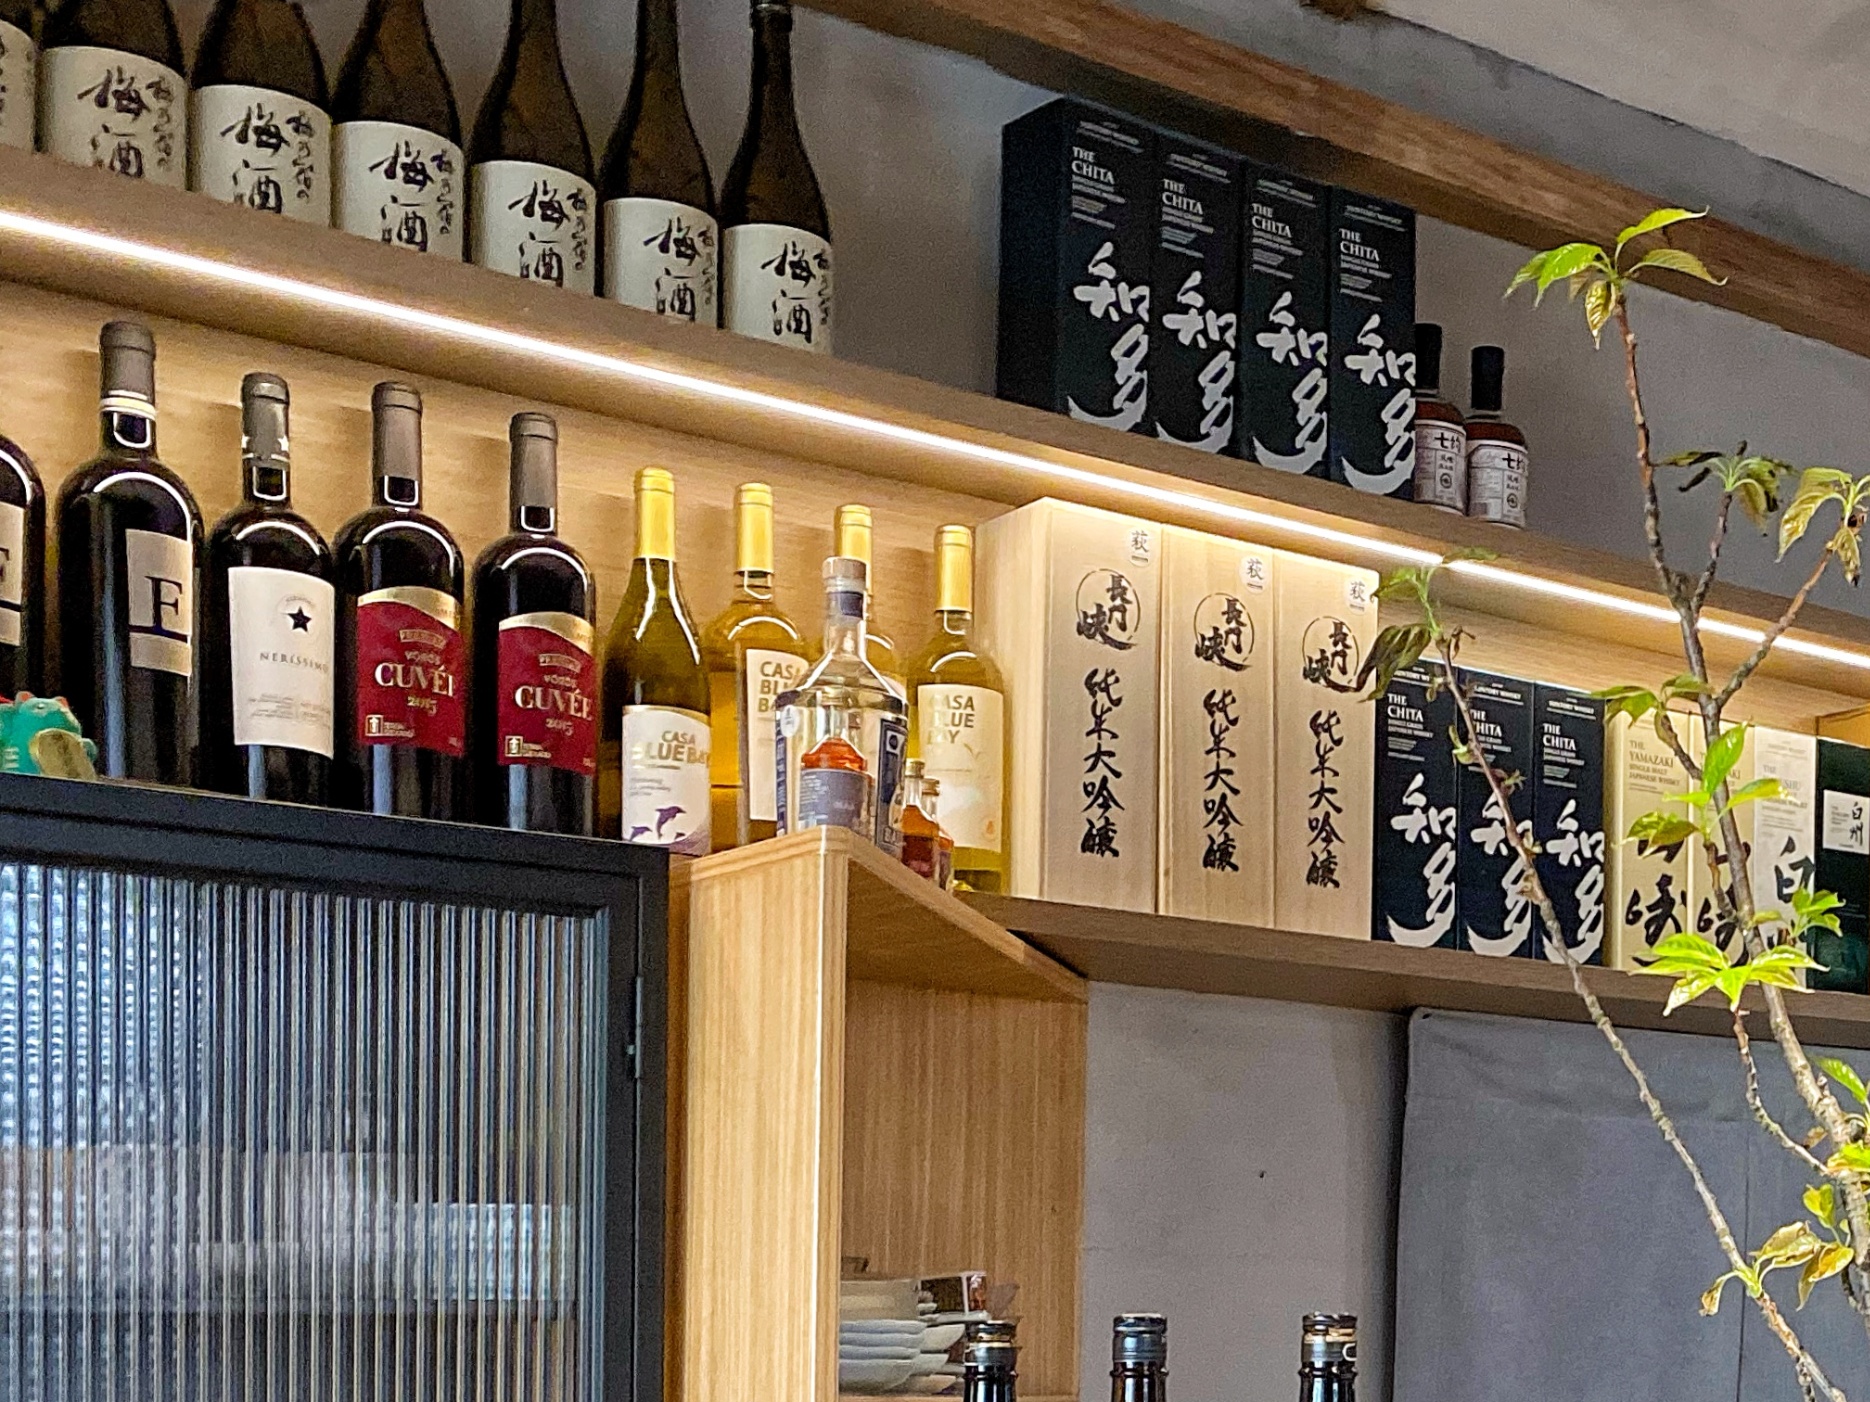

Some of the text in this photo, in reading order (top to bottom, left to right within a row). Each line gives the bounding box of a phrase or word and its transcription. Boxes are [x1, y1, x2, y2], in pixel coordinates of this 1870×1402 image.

[220, 103, 291, 214] 梅酒
[1072, 146, 1096, 163] THE
[1071, 160, 1115, 185] CHITA
[1162, 178, 1186, 195] THE
[369, 140, 434, 252] 梅酒
[1161, 191, 1204, 215] CHITA
[1252, 203, 1274, 218] THE
[508, 179, 571, 288] 梅酒
[1251, 216, 1292, 239] CHITA
[1340, 228, 1361, 244] THE
[1339, 241, 1380, 263] CHITA
[643, 216, 702, 322] 梅酒
[761, 241, 817, 343] 梅酒
[514, 685, 594, 721] CUVÉE
[1387, 693, 1407, 706] THE
[1387, 706, 1424, 723] CHITA
[662, 730, 695, 744] CASA
[1473, 721, 1502, 738] HITA
[1543, 723, 1561, 735] THE
[1543, 735, 1576, 751] CHITA
[1629, 740, 1645, 750] THE
[1629, 751, 1674, 768] YAMAZAKI
[1849, 801, 1864, 846] 白州
